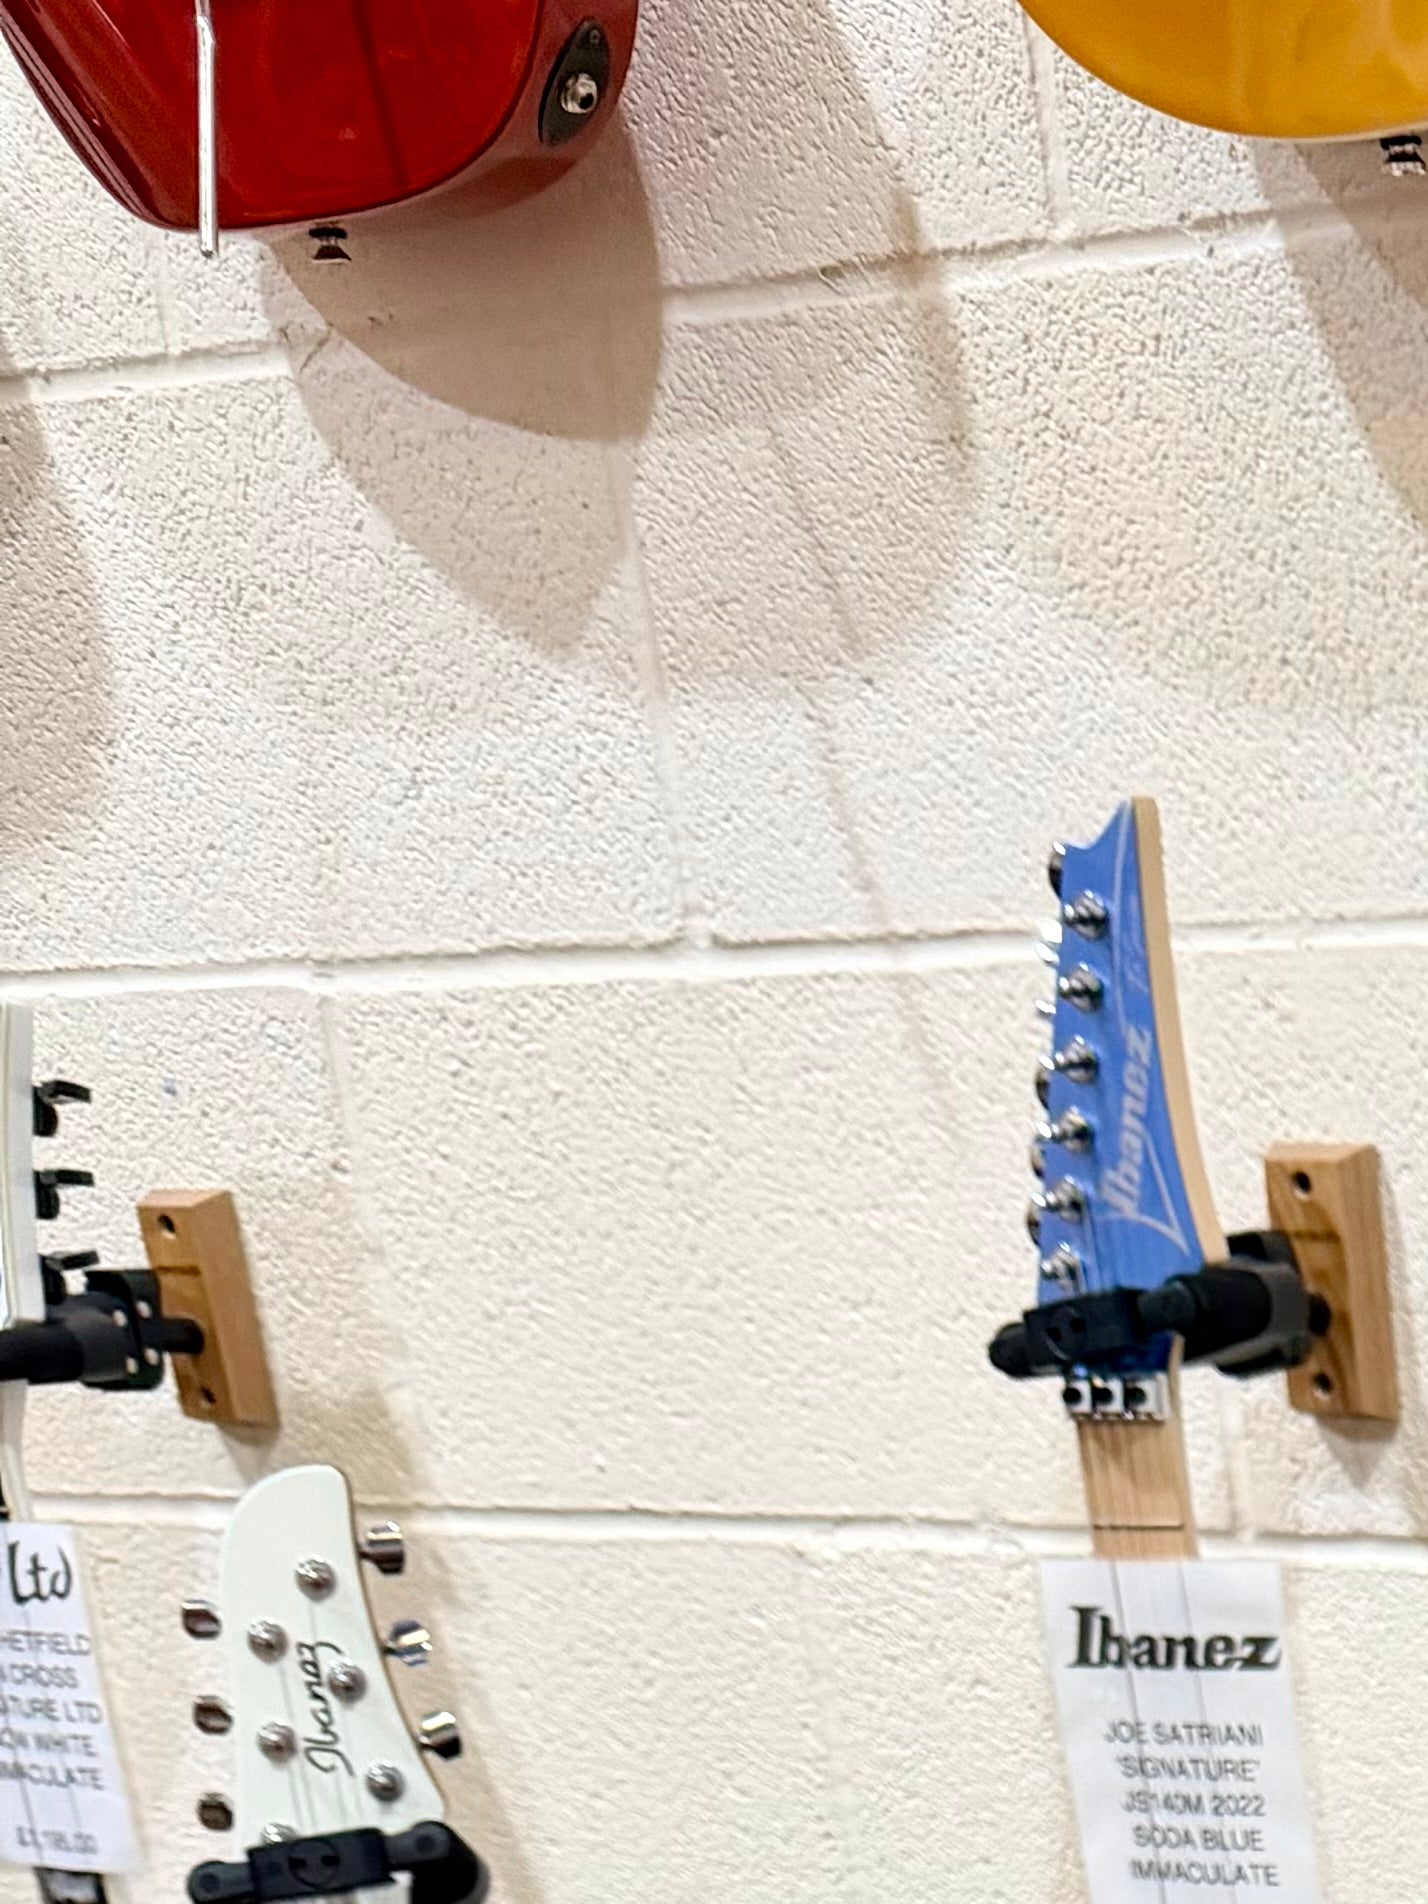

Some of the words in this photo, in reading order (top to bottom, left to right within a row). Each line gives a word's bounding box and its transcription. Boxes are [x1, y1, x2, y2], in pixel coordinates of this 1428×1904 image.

[1102, 1026, 1151, 1217] Ibanez
[1067, 1604, 1283, 1671] Ibanez
[1104, 1721, 1148, 1745] JOE
[1153, 1722, 1264, 1747] SATRIANI
[1212, 1794, 1267, 1818] 2022
[1132, 1826, 1197, 1851] SODA
[1201, 1828, 1265, 1854] BLUE
[1129, 1859, 1281, 1888] IMMACULATE
